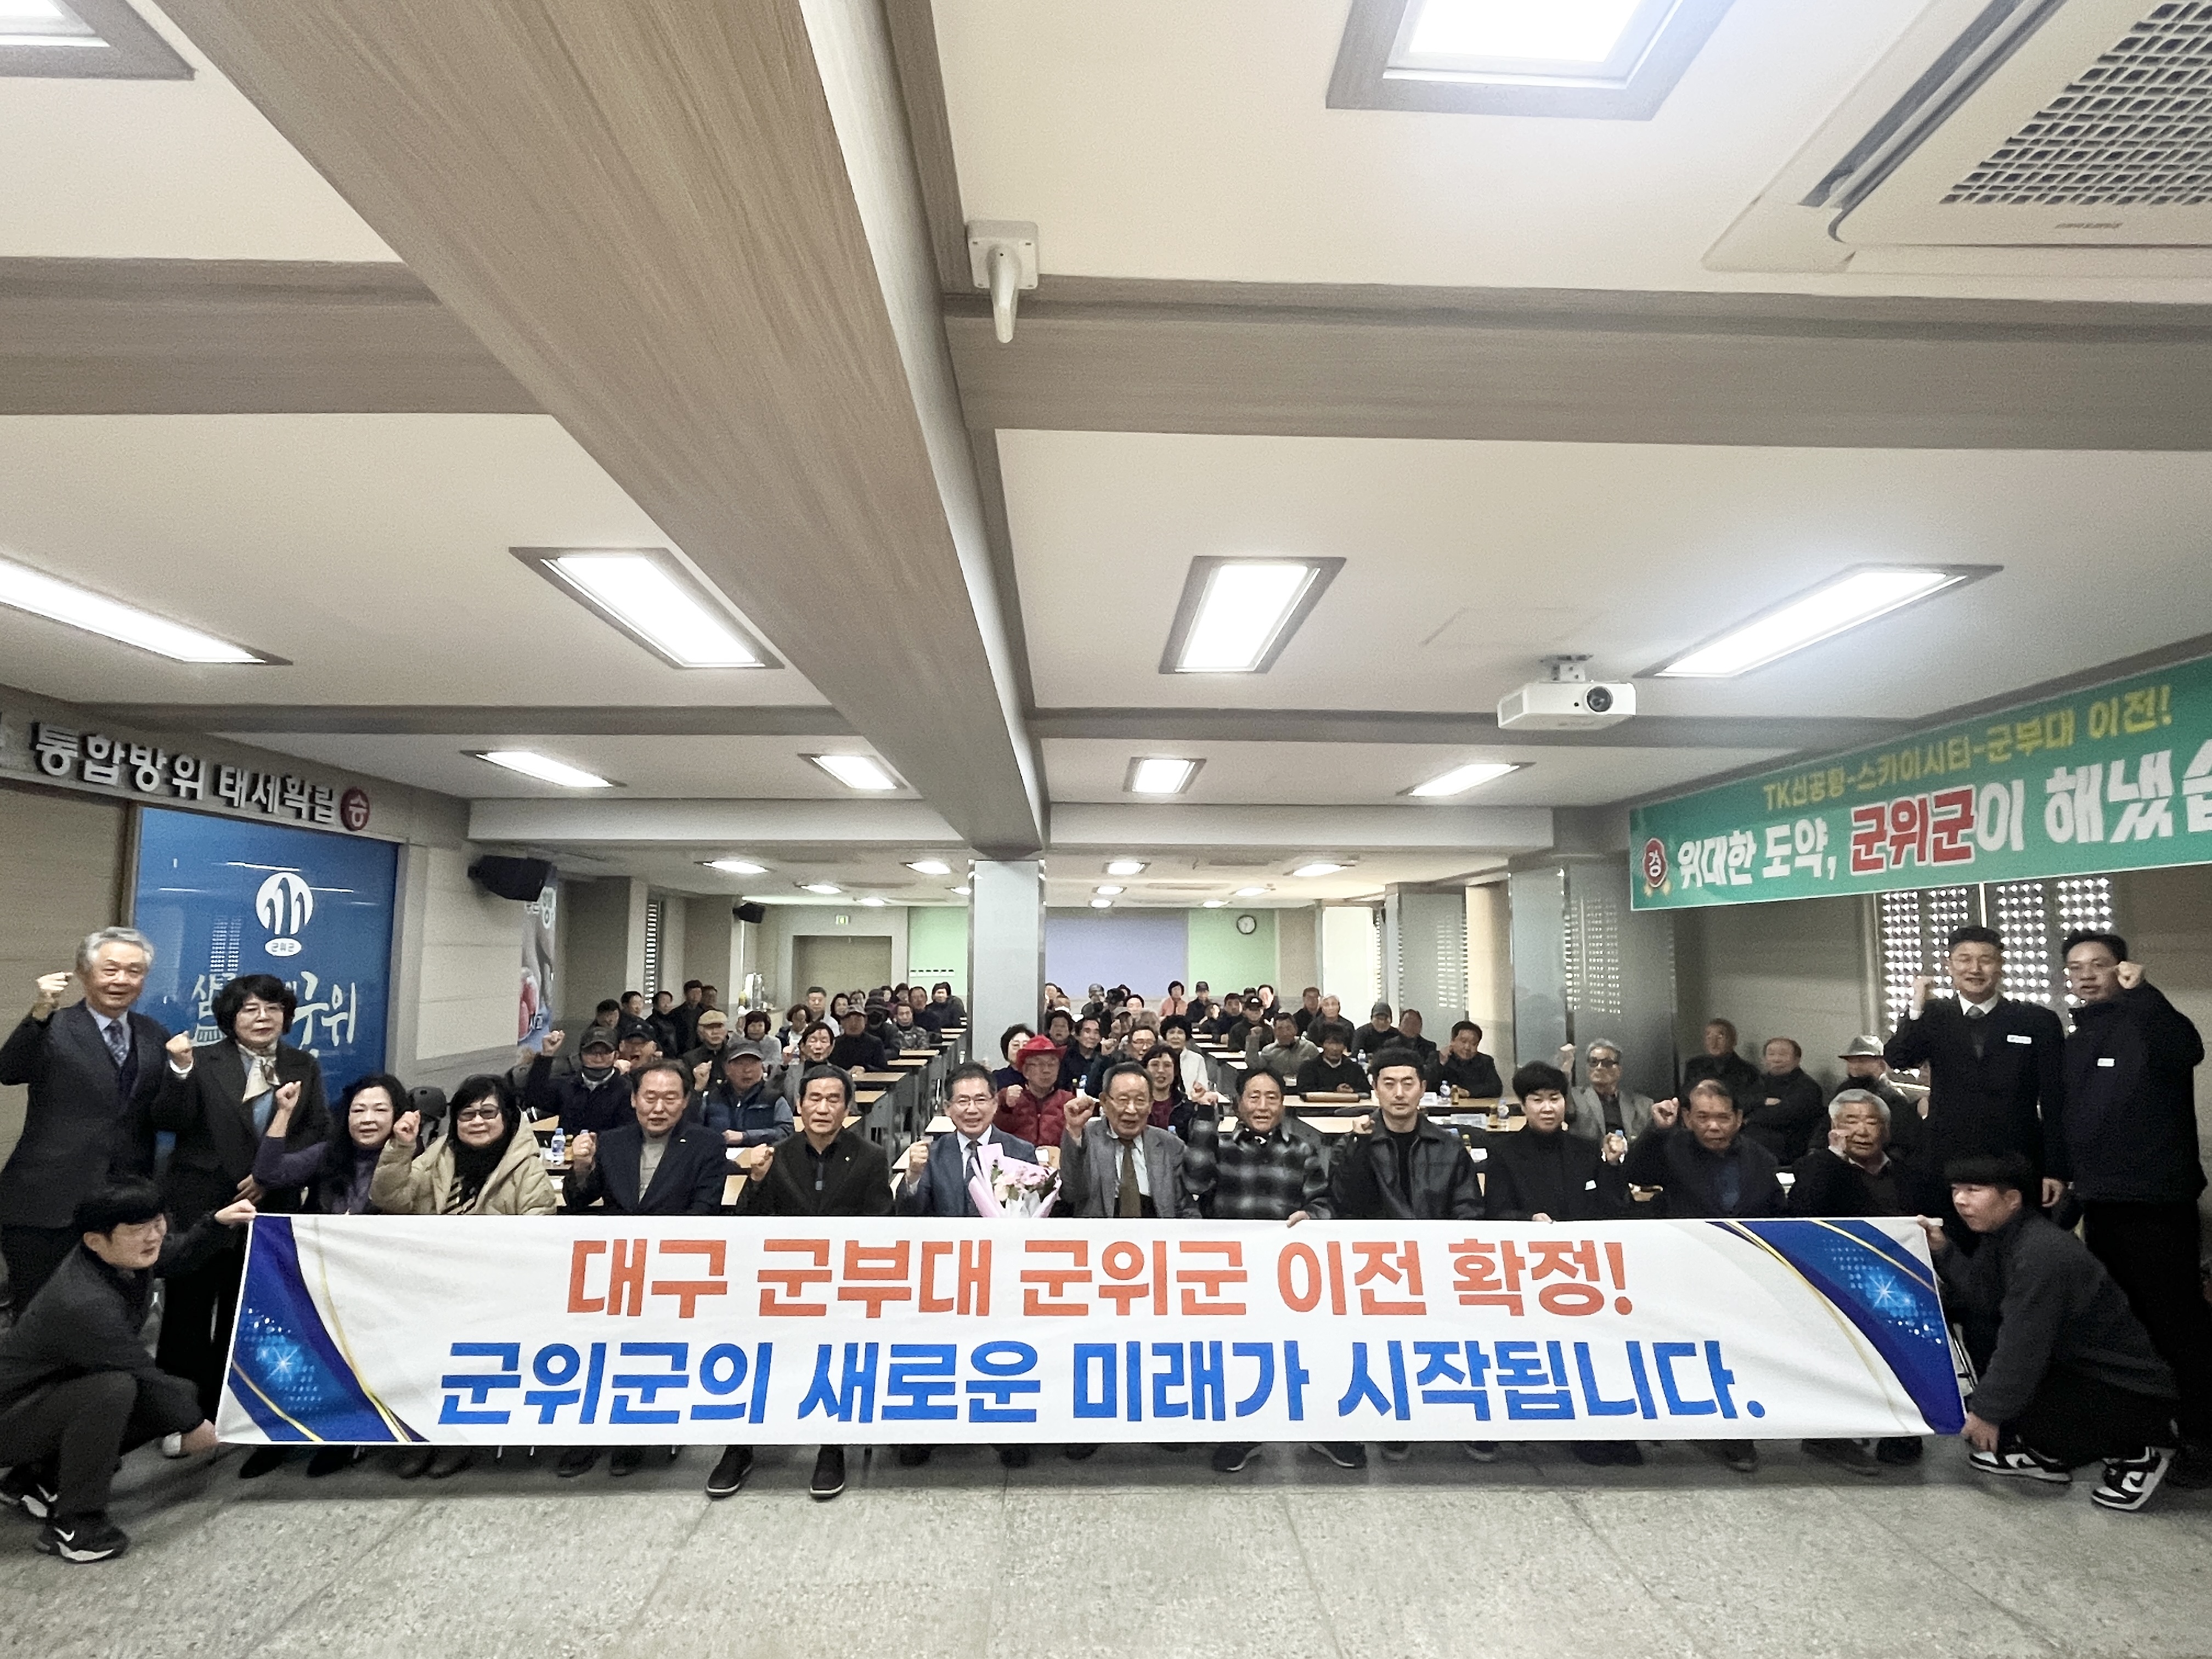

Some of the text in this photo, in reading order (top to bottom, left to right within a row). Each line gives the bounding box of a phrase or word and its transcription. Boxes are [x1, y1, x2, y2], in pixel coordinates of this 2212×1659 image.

[2087, 684, 2172, 739] 이전!
[35, 723, 336, 824] 통합방위 태세확립
[1678, 829, 1757, 889] 위대한
[1763, 817, 1837, 880] 도약,
[1850, 779, 2024, 876] 군위군이
[568, 1239, 1633, 1319] 대구 군부대 군위군 이전 확정!
[438, 1340, 1765, 1425] 군위군의 새로운 미래가 시작됩니다.
